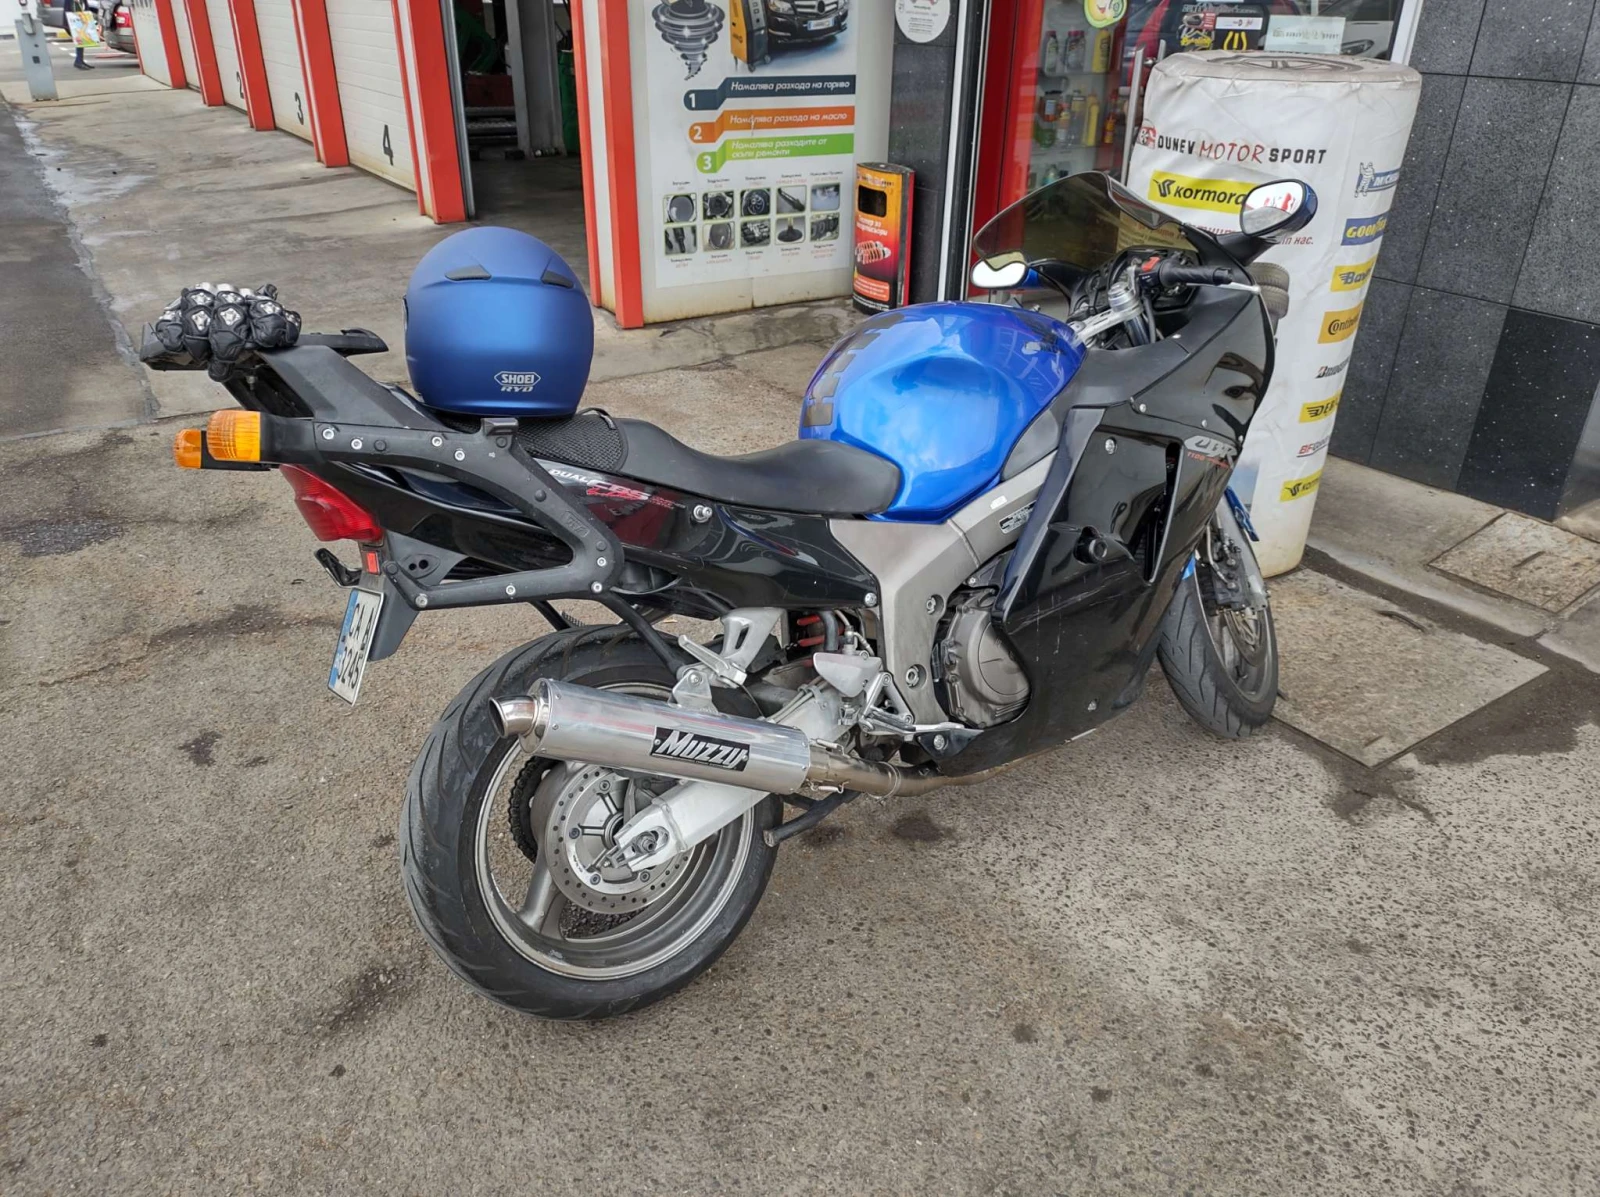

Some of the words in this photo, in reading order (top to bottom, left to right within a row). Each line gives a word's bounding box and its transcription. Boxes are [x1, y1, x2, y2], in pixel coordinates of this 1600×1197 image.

[236, 71, 244, 99] 2
[731, 82, 774, 91] Намалява
[775, 81, 811, 92] разхода
[823, 81, 850, 90] гориво
[688, 93, 696, 108] 1
[294, 92, 304, 125] 3
[730, 115, 772, 124] Намалява
[773, 115, 808, 125] разхода
[693, 126, 703, 140] 2
[382, 124, 394, 166] 4
[731, 139, 773, 150] Намалява
[774, 138, 818, 150] разходите
[1157, 135, 1195, 155] DUNEV
[1198, 140, 1265, 164] MOTOR
[1268, 148, 1327, 164] SPORT
[732, 149, 754, 159] скъпи
[756, 149, 790, 159] ремонти
[702, 156, 712, 170] 3
[1173, 185, 1247, 206] kormora
[501, 374, 535, 384] SHOEI
[548, 468, 589, 484] DUAL
